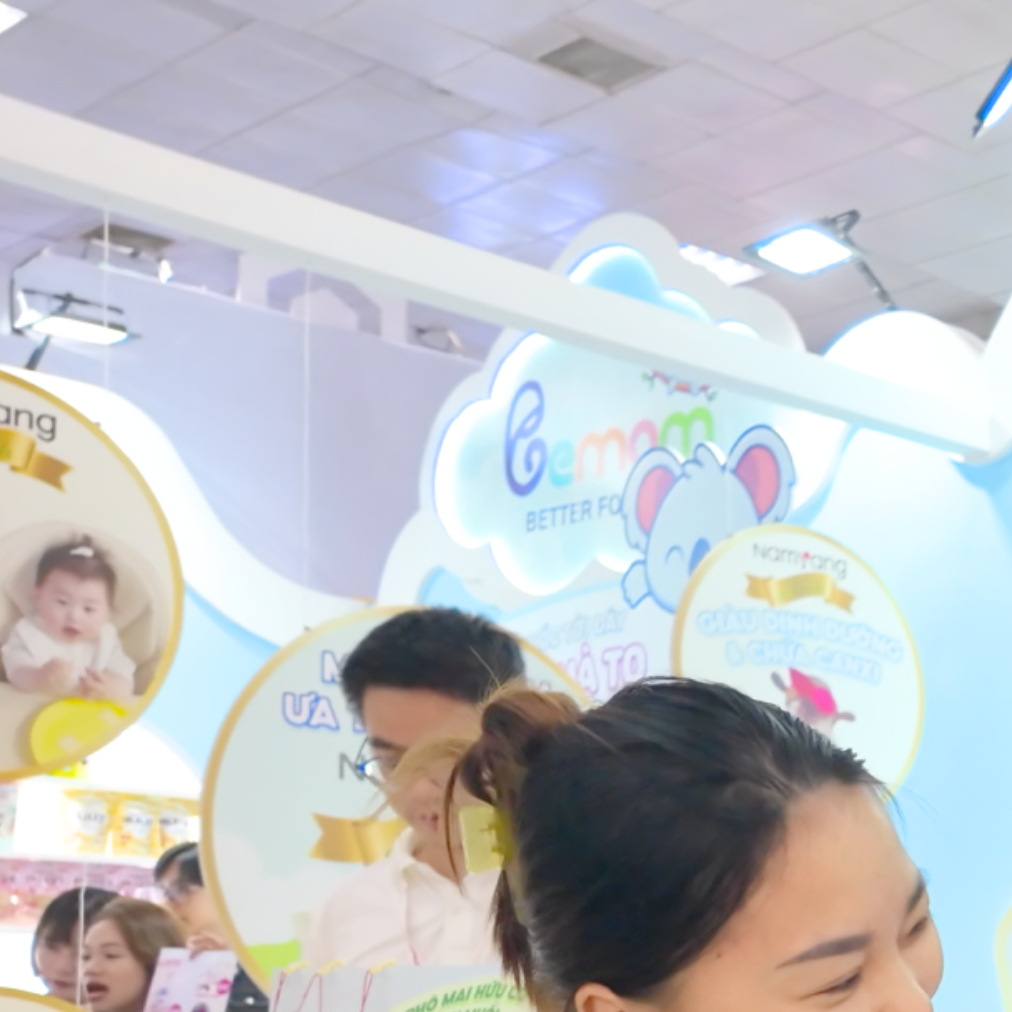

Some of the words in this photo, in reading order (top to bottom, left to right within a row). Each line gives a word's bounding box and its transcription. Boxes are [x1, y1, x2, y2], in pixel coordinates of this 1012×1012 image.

[526, 499, 592, 533] BETTER
[752, 542, 848, 580] Namyang
[282, 690, 340, 732] ƯA
[441, 984, 474, 1006] MAI
[474, 978, 508, 1001] HỮU
